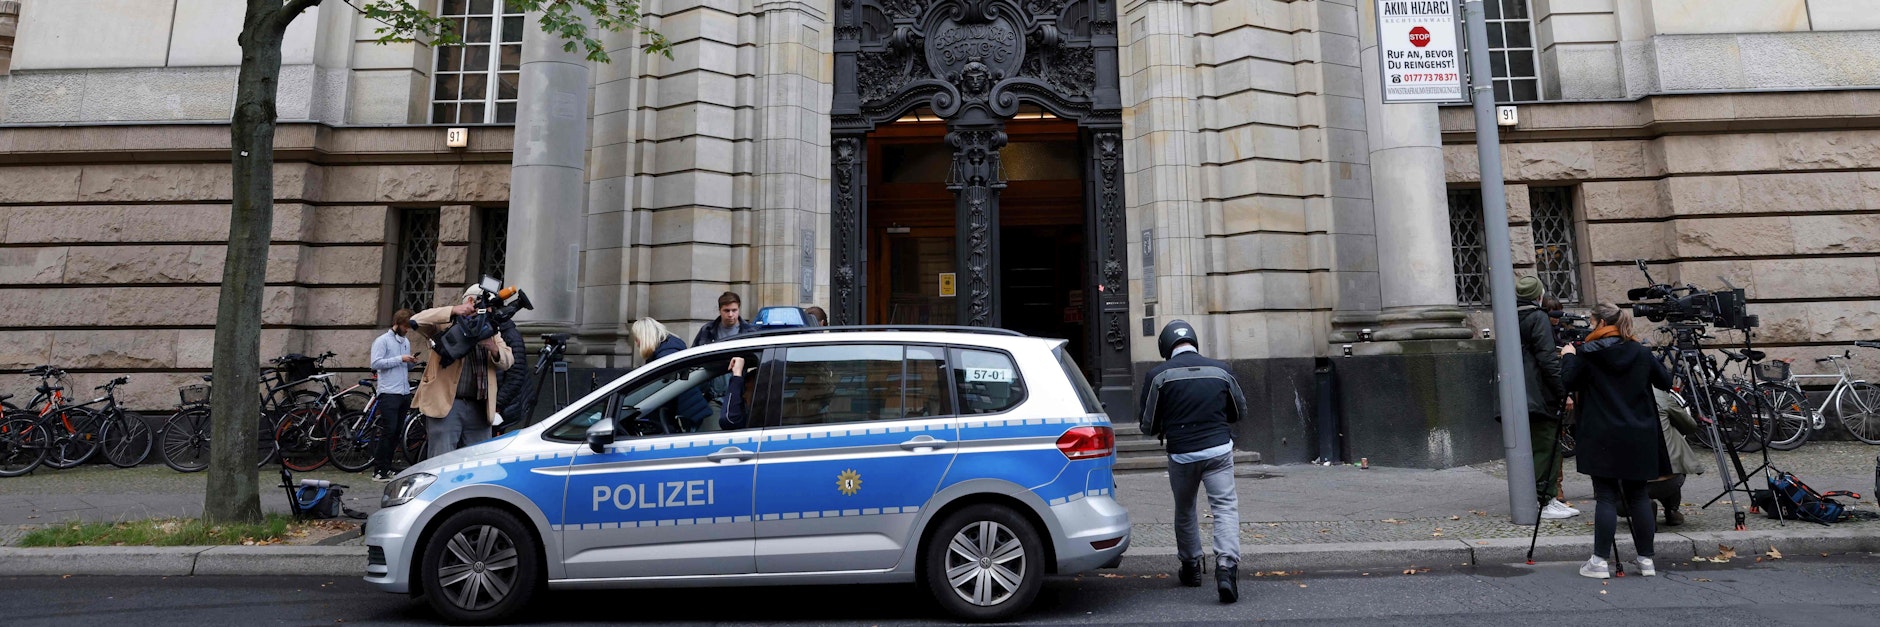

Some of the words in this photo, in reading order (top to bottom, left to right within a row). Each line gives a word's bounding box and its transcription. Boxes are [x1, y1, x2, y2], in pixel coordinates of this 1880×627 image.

[1384, 2, 1408, 15] AKIN
[1411, 1, 1449, 15] HIZARCI
[1409, 33, 1430, 41] STOP
[1407, 50, 1423, 60] AN,
[1425, 50, 1454, 58] BEVOR
[1404, 59, 1455, 69] REINGEHST!
[1404, 73, 1423, 82] 0177
[1424, 73, 1433, 82] 73
[1434, 73, 1444, 82] 78
[1445, 73, 1458, 81] 371
[1503, 109, 1514, 120] 91
[449, 131, 460, 142] 91
[973, 369, 1005, 380] 57-01
[592, 479, 714, 512] POLIZEI
